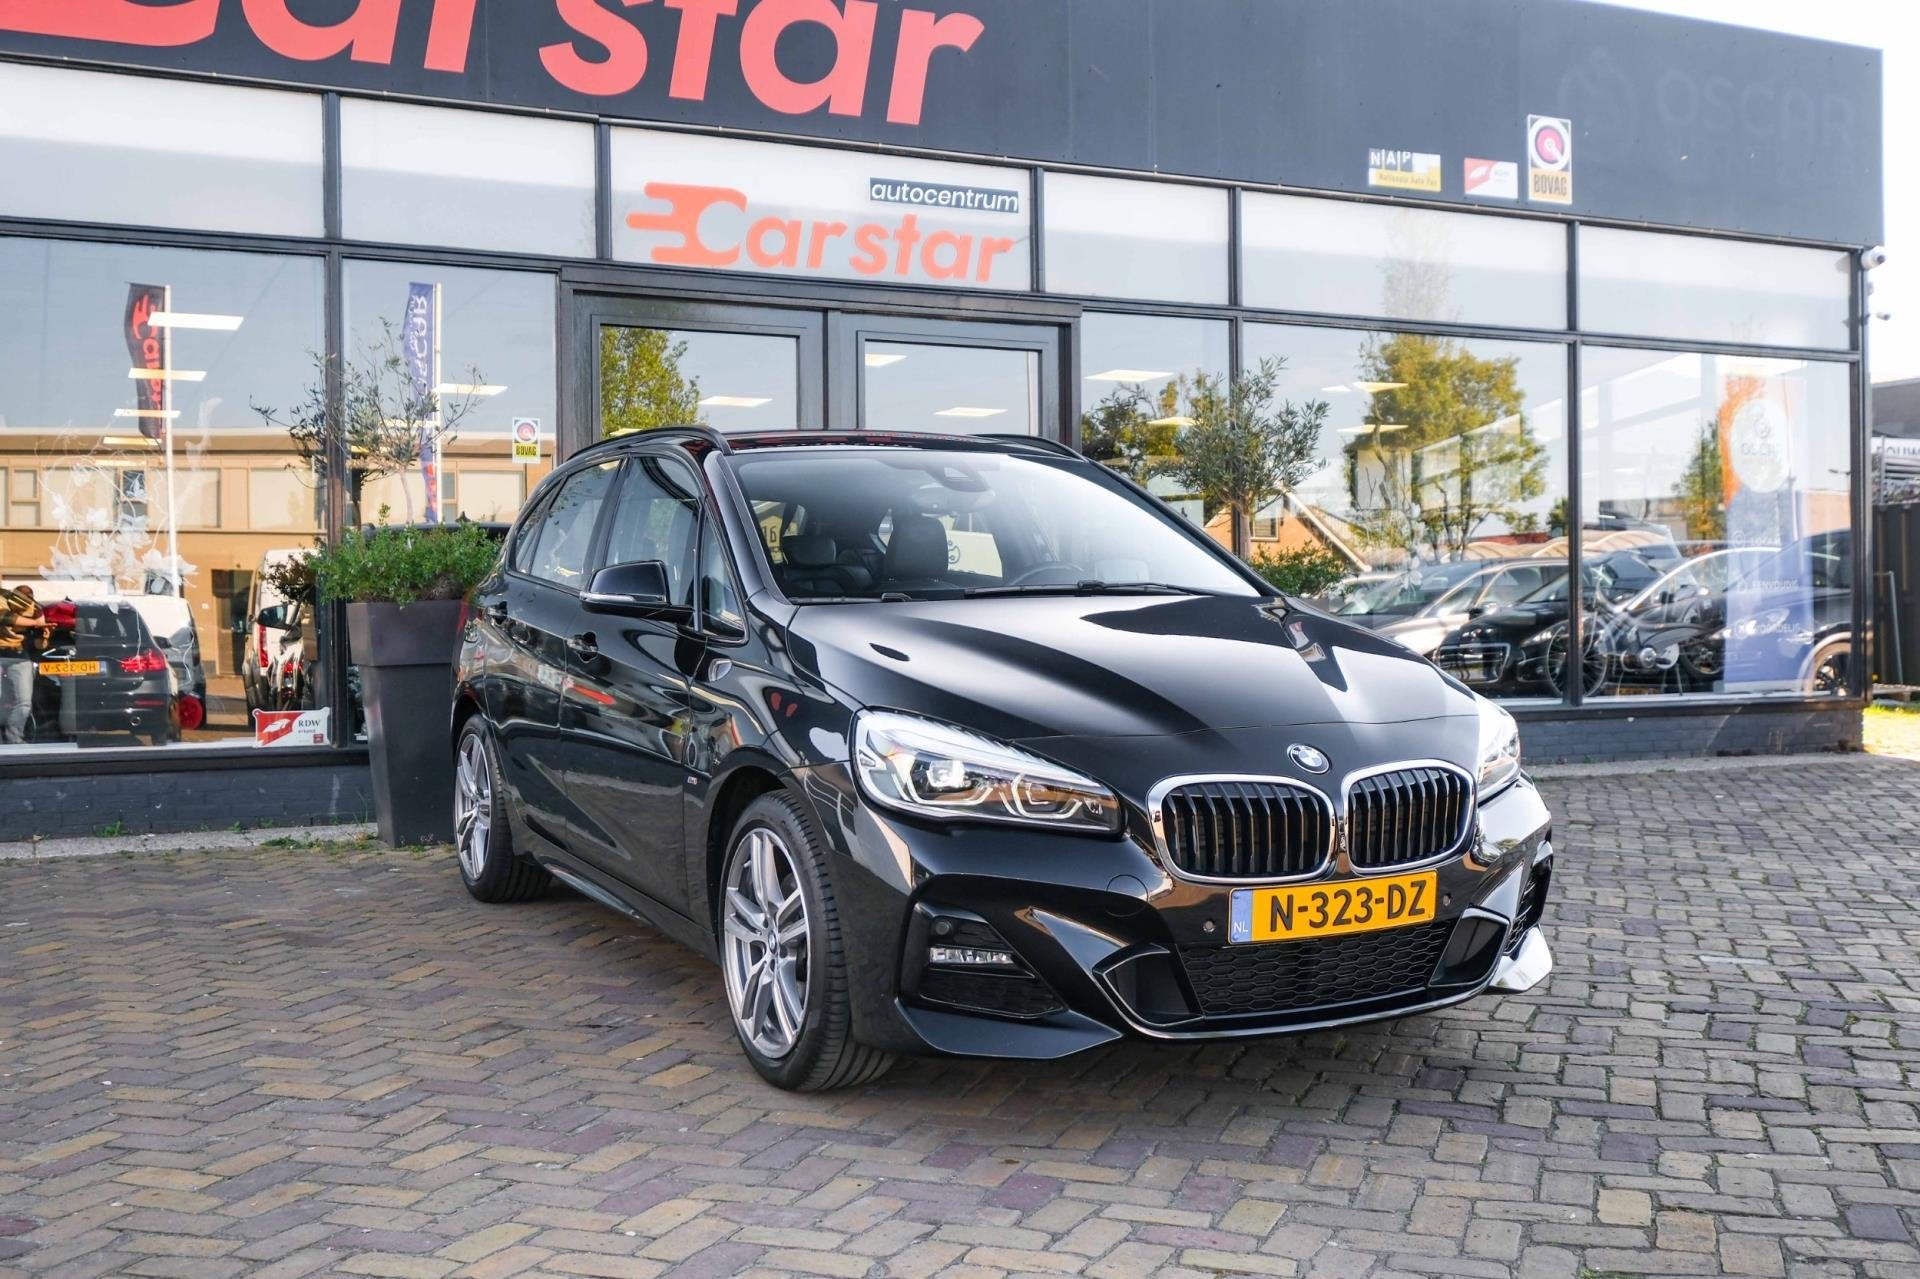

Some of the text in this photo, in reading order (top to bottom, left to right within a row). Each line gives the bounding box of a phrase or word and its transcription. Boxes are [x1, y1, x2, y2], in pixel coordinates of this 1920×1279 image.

[0, 0, 984, 125] arstar
[871, 182, 1018, 212] autocentrum
[1533, 173, 1567, 197] BOVAG
[625, 182, 1014, 283] Carstar
[515, 445, 537, 456] BOVAG
[1270, 880, 1427, 932] N-323-DZ
[1233, 921, 1249, 933] NL
